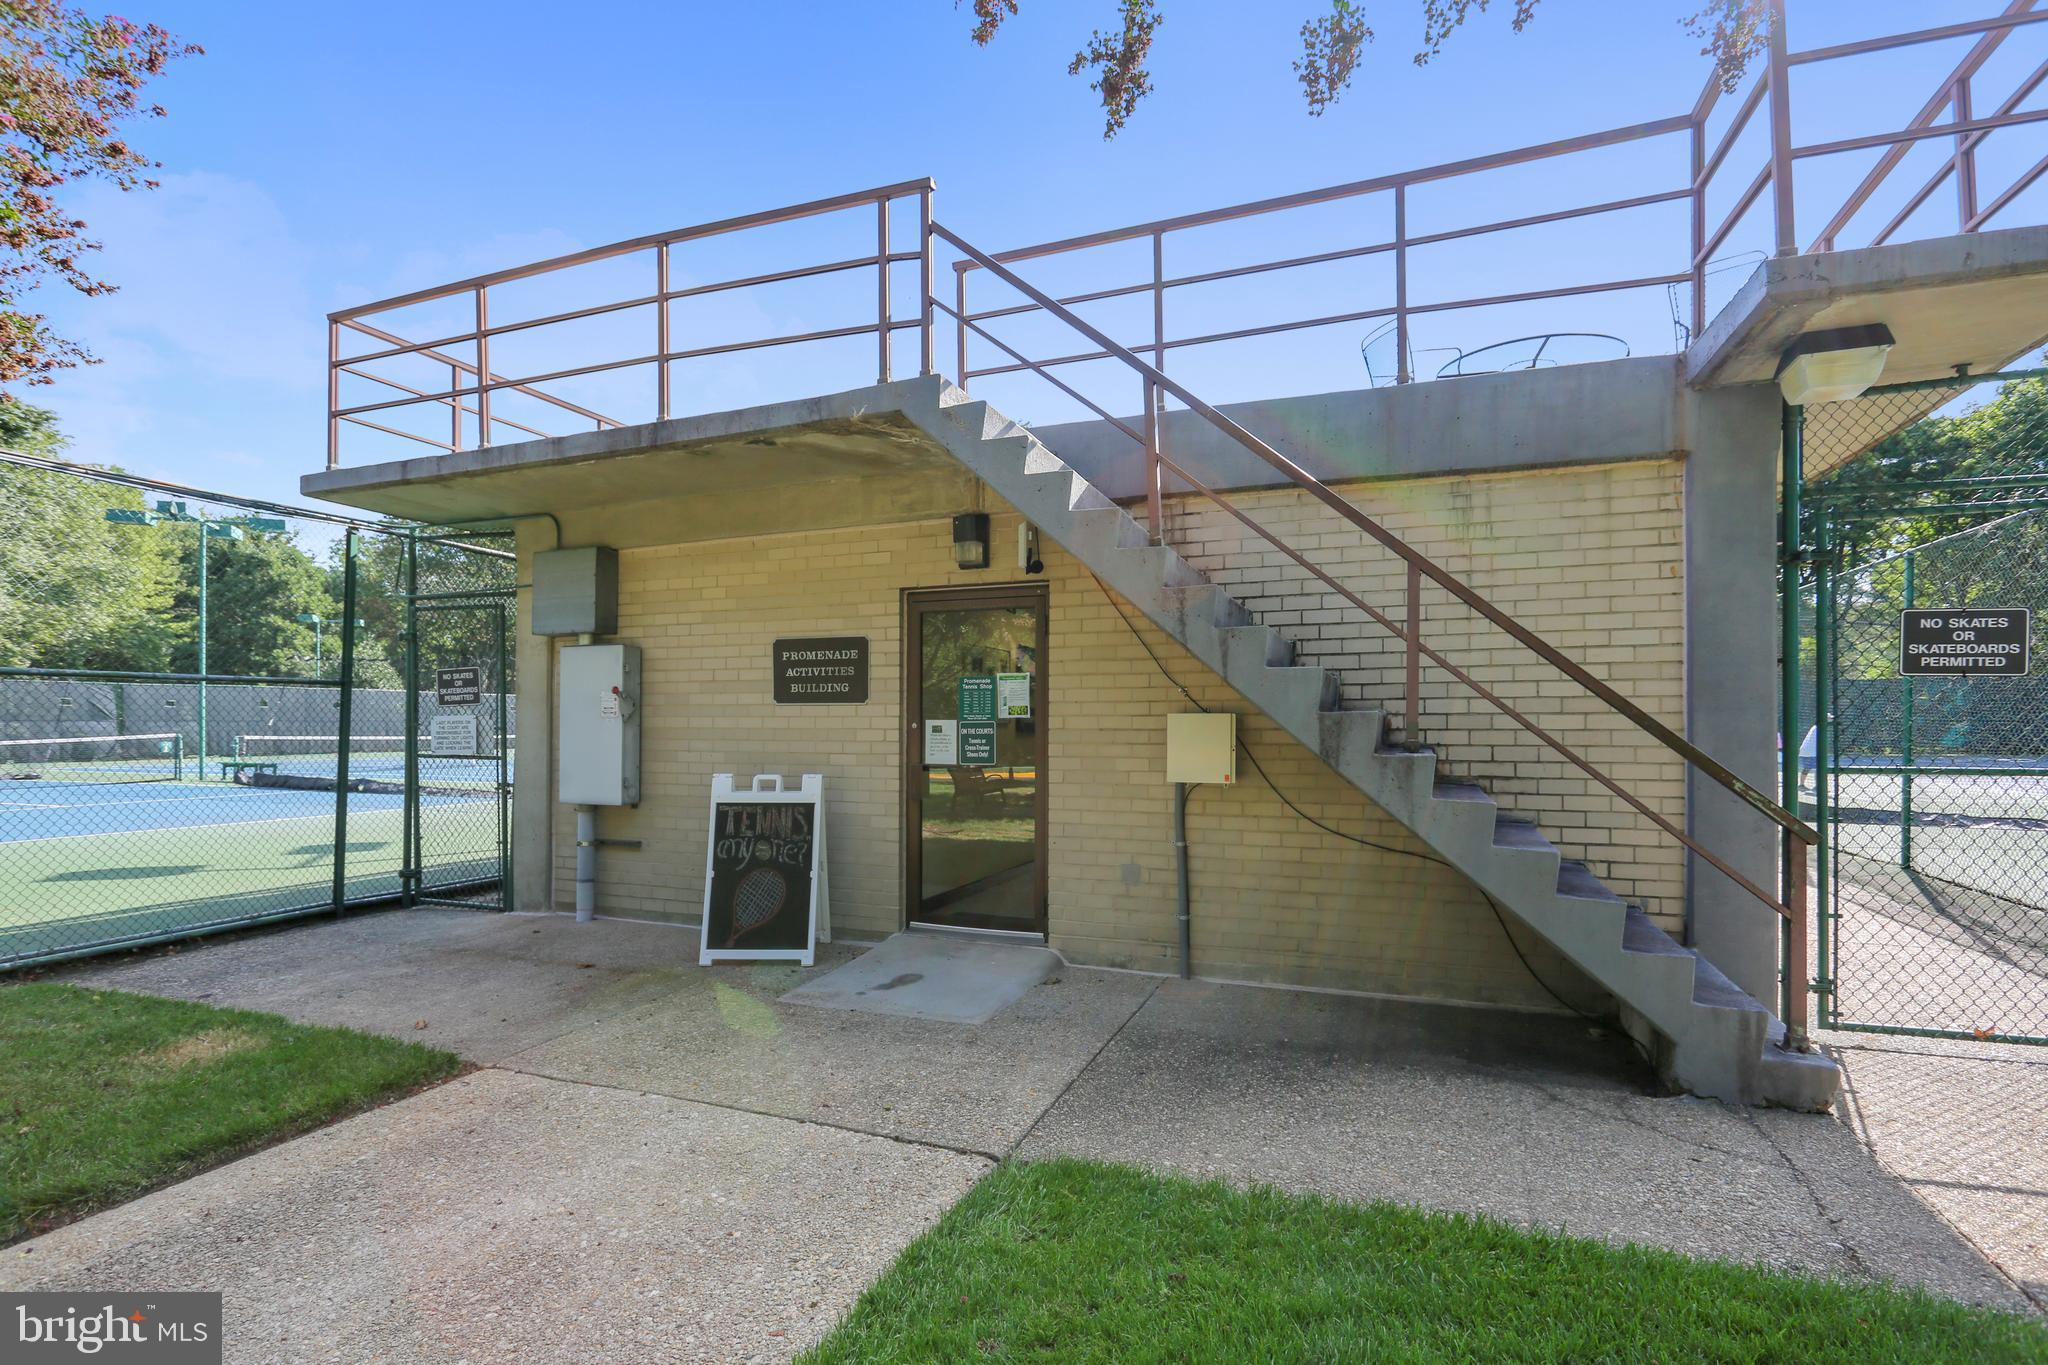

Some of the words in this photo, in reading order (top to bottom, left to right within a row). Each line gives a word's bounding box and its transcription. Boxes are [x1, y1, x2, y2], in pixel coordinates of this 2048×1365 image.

[1920, 618, 1942, 628] NO
[1949, 618, 2009, 628] SKATES
[1952, 631, 1975, 641] OR
[1908, 643, 2021, 654] SKATEBOARDS
[782, 650, 858, 661] PROMENADE
[1920, 657, 2006, 667] PERMITTED
[785, 666, 855, 677] ACTIVITIES
[790, 683, 850, 693] BUILDING
